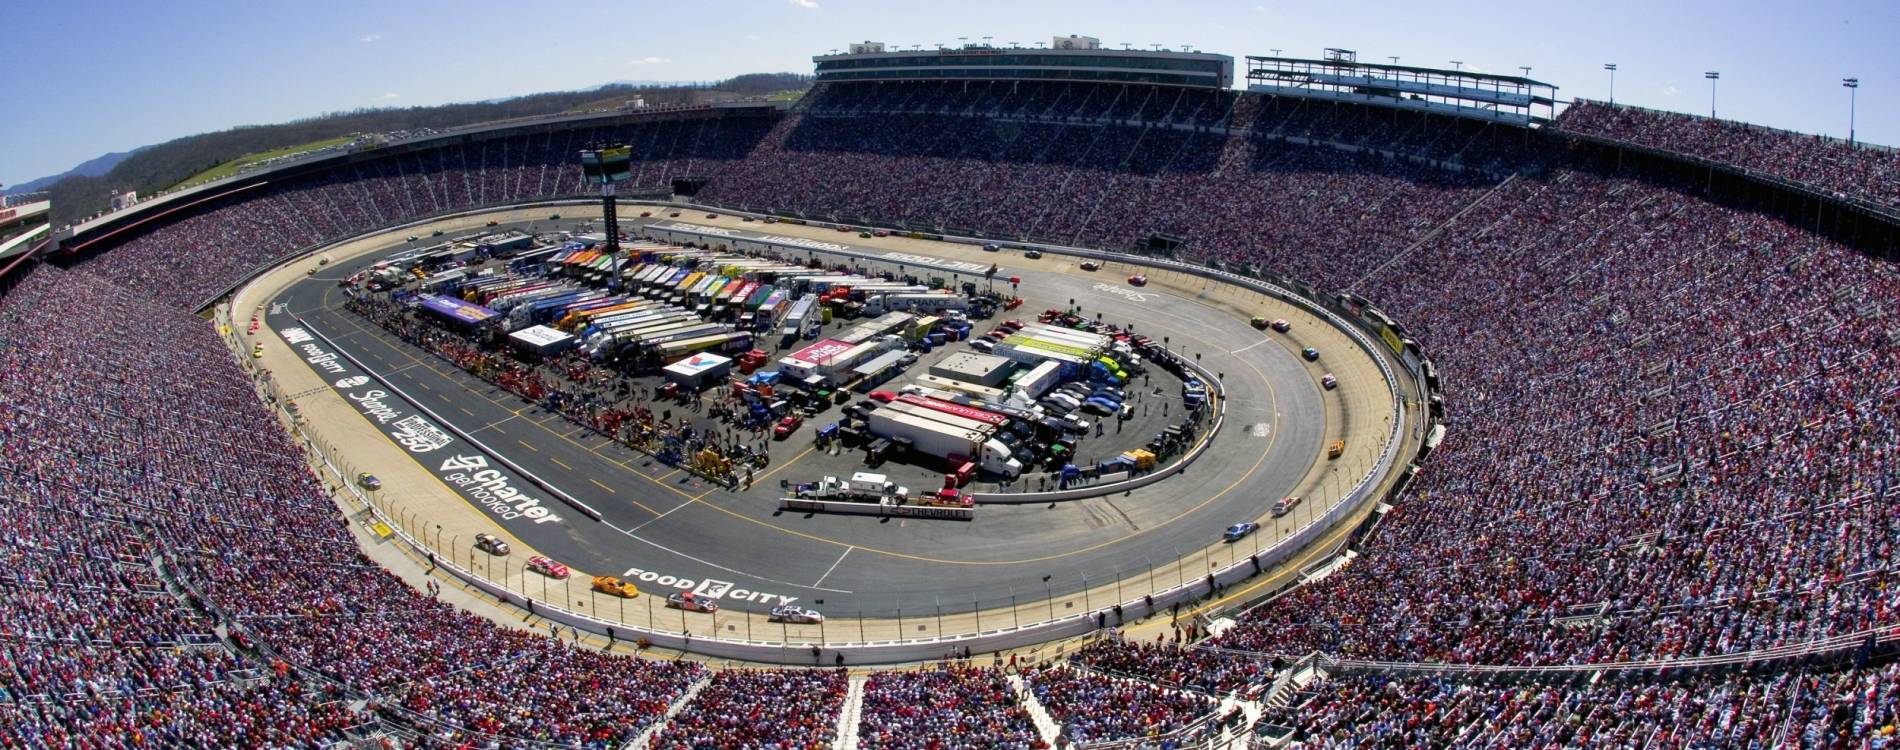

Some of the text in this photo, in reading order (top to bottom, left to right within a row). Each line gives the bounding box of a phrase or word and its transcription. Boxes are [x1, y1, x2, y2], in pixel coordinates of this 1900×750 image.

[1093, 282, 1160, 302] Sharpie
[301, 343, 347, 374] FOOD CITY
[349, 389, 402, 425] Sharpie
[392, 428, 438, 453] 250
[401, 416, 449, 447] PROFESSIONAL
[445, 471, 525, 520] get hooked
[471, 467, 563, 524] Charter
[911, 507, 967, 518] CHEVROLET
[623, 567, 800, 606] FOOD CITY
